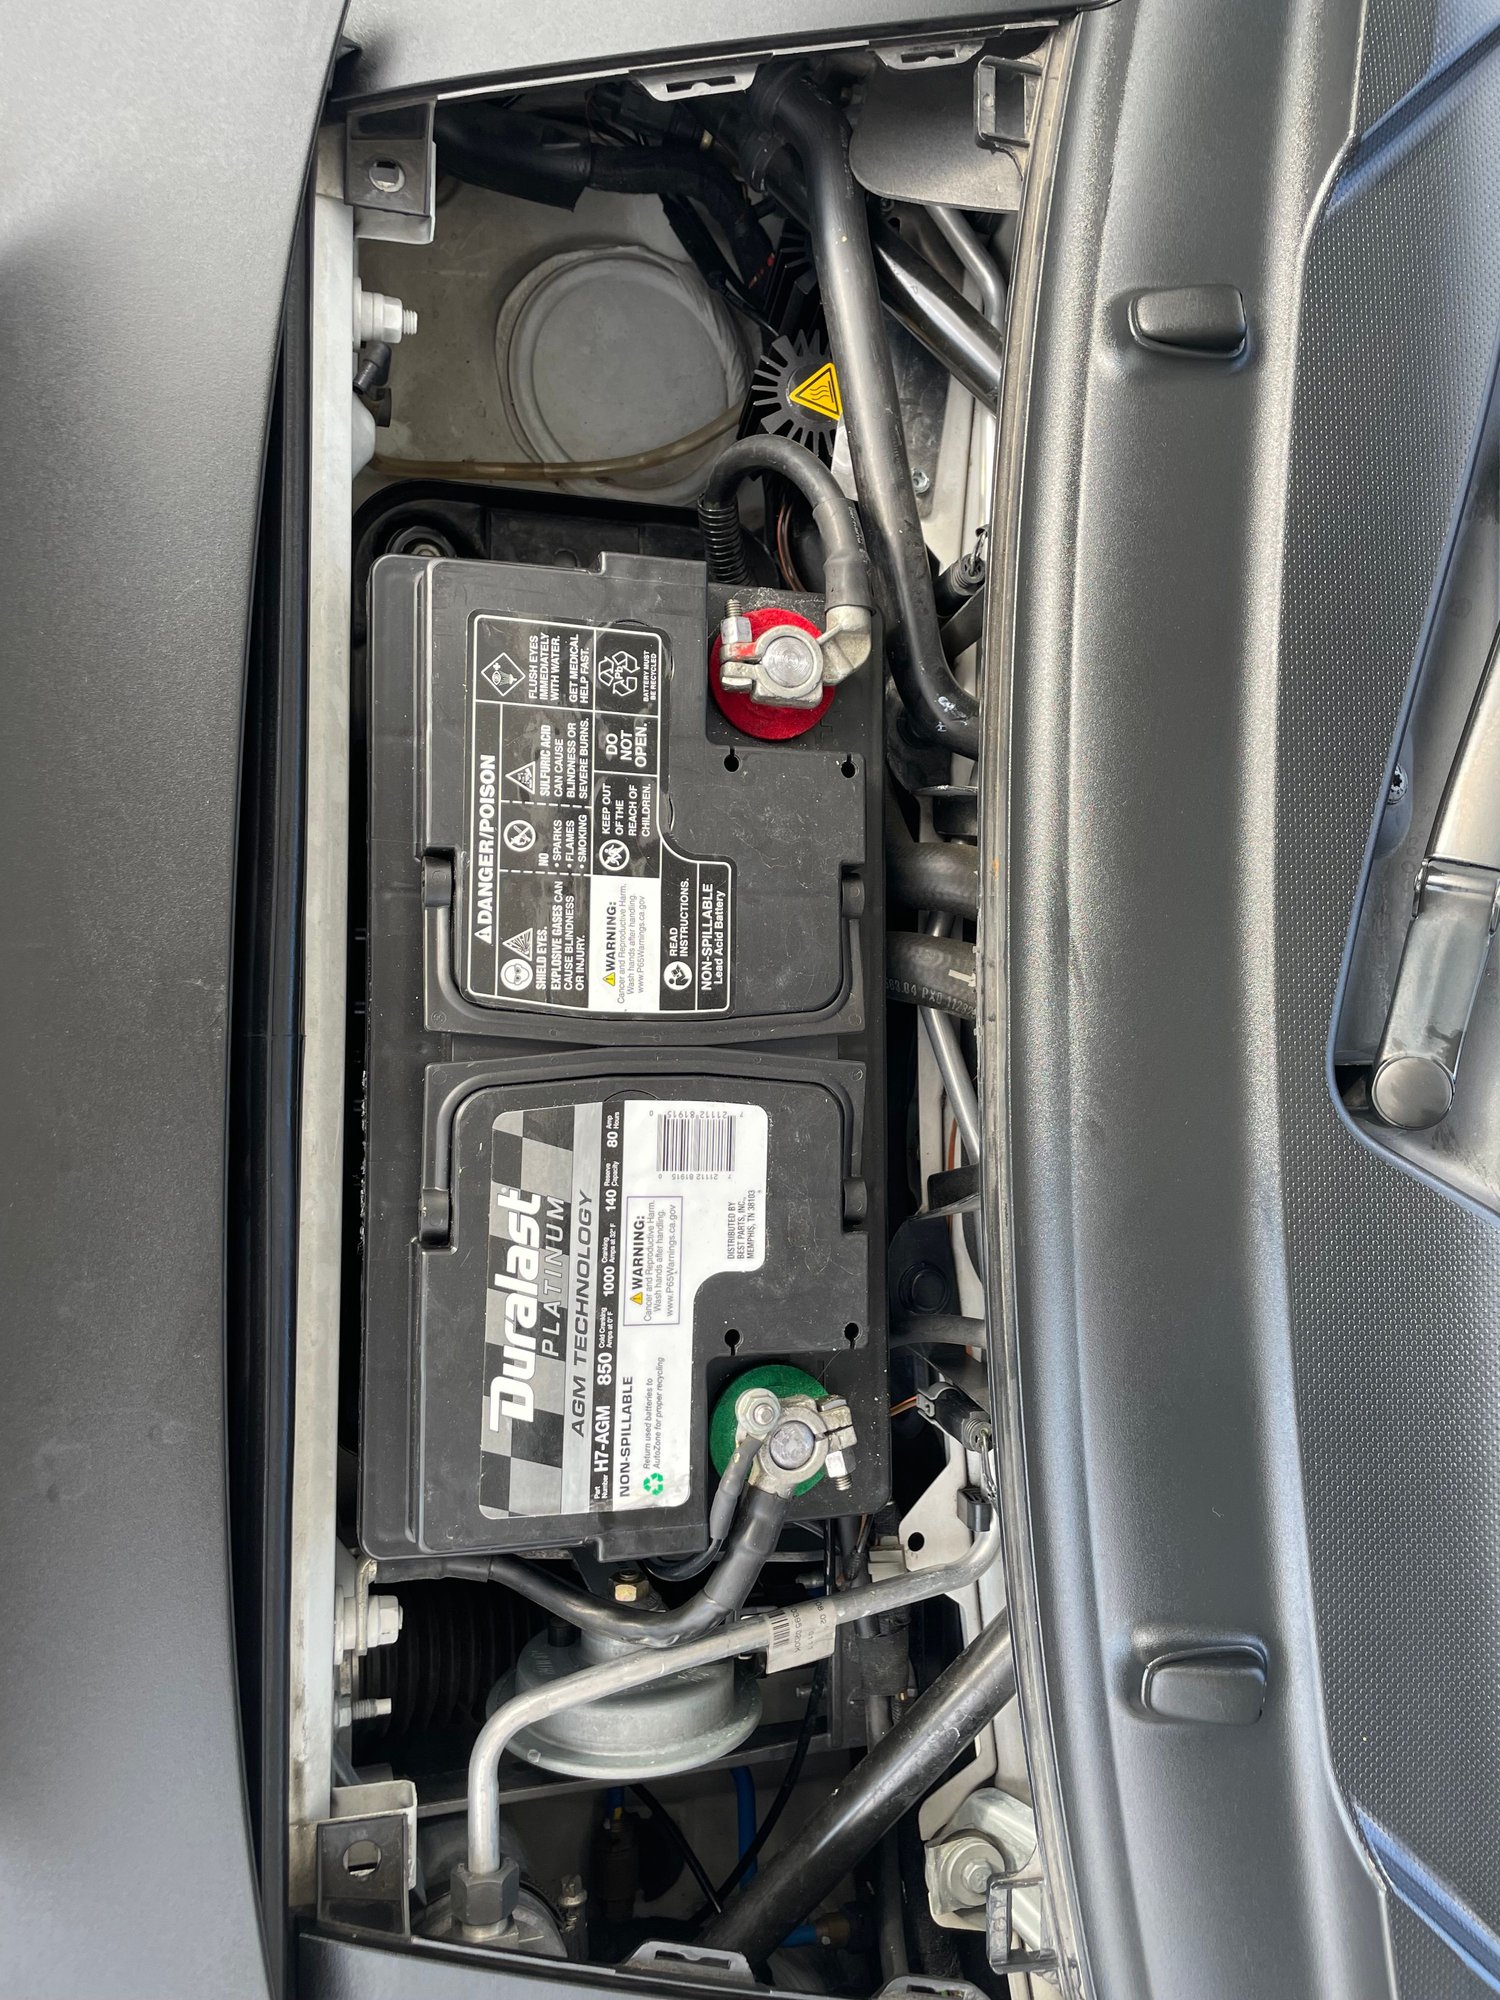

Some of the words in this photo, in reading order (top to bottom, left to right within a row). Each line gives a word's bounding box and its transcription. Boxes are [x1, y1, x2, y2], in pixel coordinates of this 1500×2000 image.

[530, 636, 538, 662] EYES
[551, 636, 560, 673] WATER.
[570, 634, 579, 679] MEDICAL
[581, 648, 589, 674] FAST.
[540, 633, 549, 700] IMMEDIATELY
[615, 667, 624, 679] Pb
[529, 665, 538, 698] FLUSH
[551, 675, 559, 701] WITH
[570, 681, 578, 702] GET
[581, 676, 589, 703] HELP
[651, 691, 656, 700] BE
[540, 725, 551, 748] ACID
[568, 723, 576, 737] OR
[580, 718, 589, 756] BURNS.
[555, 739, 563, 773] CAUSE
[606, 734, 618, 755] DO
[620, 730, 633, 761] NOT
[635, 723, 647, 767] OPEN.
[540, 750, 550, 796] SULFURIC
[567, 741, 576, 797] BLINDNESS
[579, 758, 589, 799] SEVERE
[554, 776, 563, 797] CAN
[602, 783, 611, 804] OUT
[629, 785, 637, 799] OF
[602, 807, 610, 834] KEEP
[616, 800, 624, 819] THE
[629, 801, 637, 836] REACH
[641, 784, 651, 836] CHILDREN.
[477, 754, 496, 924] DANGER/POISON
[553, 820, 562, 860] SPARKS
[566, 820, 575, 861] FLAMES
[578, 815, 588, 862] SMOKING
[615, 821, 623, 835] OF
[539, 853, 548, 866] NO
[554, 881, 563, 902] CAN
[552, 905, 563, 935] GASES
[680, 878, 690, 956] INSTRUCTIONS.
[715, 891, 725, 929] Battery
[565, 896, 574, 953] BLINDNESS
[606, 901, 616, 971] WARNING:
[619, 909, 627, 958] Reproductive
[702, 884, 713, 990] NON-SPILLABLE
[537, 926, 548, 953] EYES.
[637, 896, 646, 993] www.P65Warnings.ca.gov
[670, 928, 678, 956] READ
[714, 932, 724, 955] Acid
[551, 939, 562, 990] EXPLOSIVE
[577, 935, 586, 973] INJURY.
[618, 960, 626, 974] and
[627, 948, 635, 971] hands
[536, 956, 547, 990] SHIELD
[564, 956, 573, 990] CAUSE
[576, 976, 584, 990] OR
[627, 973, 635, 994] Wash
[714, 958, 723, 984] Lead
[617, 977, 625, 1004] Cancer
[667, 1110, 696, 1119] 81915
[700, 1110, 728, 1119] 21112
[607, 1131, 618, 1148] 80
[605, 1190, 616, 1212] 140
[728, 1202, 736, 1213] BY
[747, 1190, 755, 1211] 38103
[656, 1210, 665, 1244] handling.
[737, 1215, 746, 1239] PARTS,
[747, 1213, 755, 1222] TN
[601, 1237, 609, 1263] Cranking
[645, 1226, 655, 1275] Reproductive
[728, 1215, 736, 1259] DISTRIBUTED
[737, 1242, 745, 1259] BEST
[747, 1224, 756, 1259] MEMPHIS,
[632, 1215, 644, 1290] WARNING:
[655, 1246, 663, 1263] after
[666, 1205, 677, 1316] www.P65Warnings.ca.gov
[541, 1196, 565, 1356] PLATINUM
[574, 1189, 592, 1366] TECHNOLOGY
[603, 1266, 614, 1296] 1000
[645, 1277, 653, 1292] and
[654, 1265, 663, 1288] hands
[489, 1189, 541, 1432] Duralast
[644, 1294, 652, 1321] Cancer
[654, 1291, 662, 1312] Wash
[599, 1307, 607, 1333] Cranking
[597, 1352, 613, 1385] 850
[646, 1378, 653, 1386] to
[656, 1357, 664, 1391] recycling
[572, 1376, 587, 1437] AGM
[645, 1388, 653, 1421] batteries
[655, 1393, 663, 1418] proper
[594, 1405, 610, 1472] H7-AGM
[619, 1376, 633, 1497] NON-SPILLABLE
[644, 1423, 652, 1441] used
[643, 1443, 651, 1469] Return
[601, 1474, 609, 1499] Number
